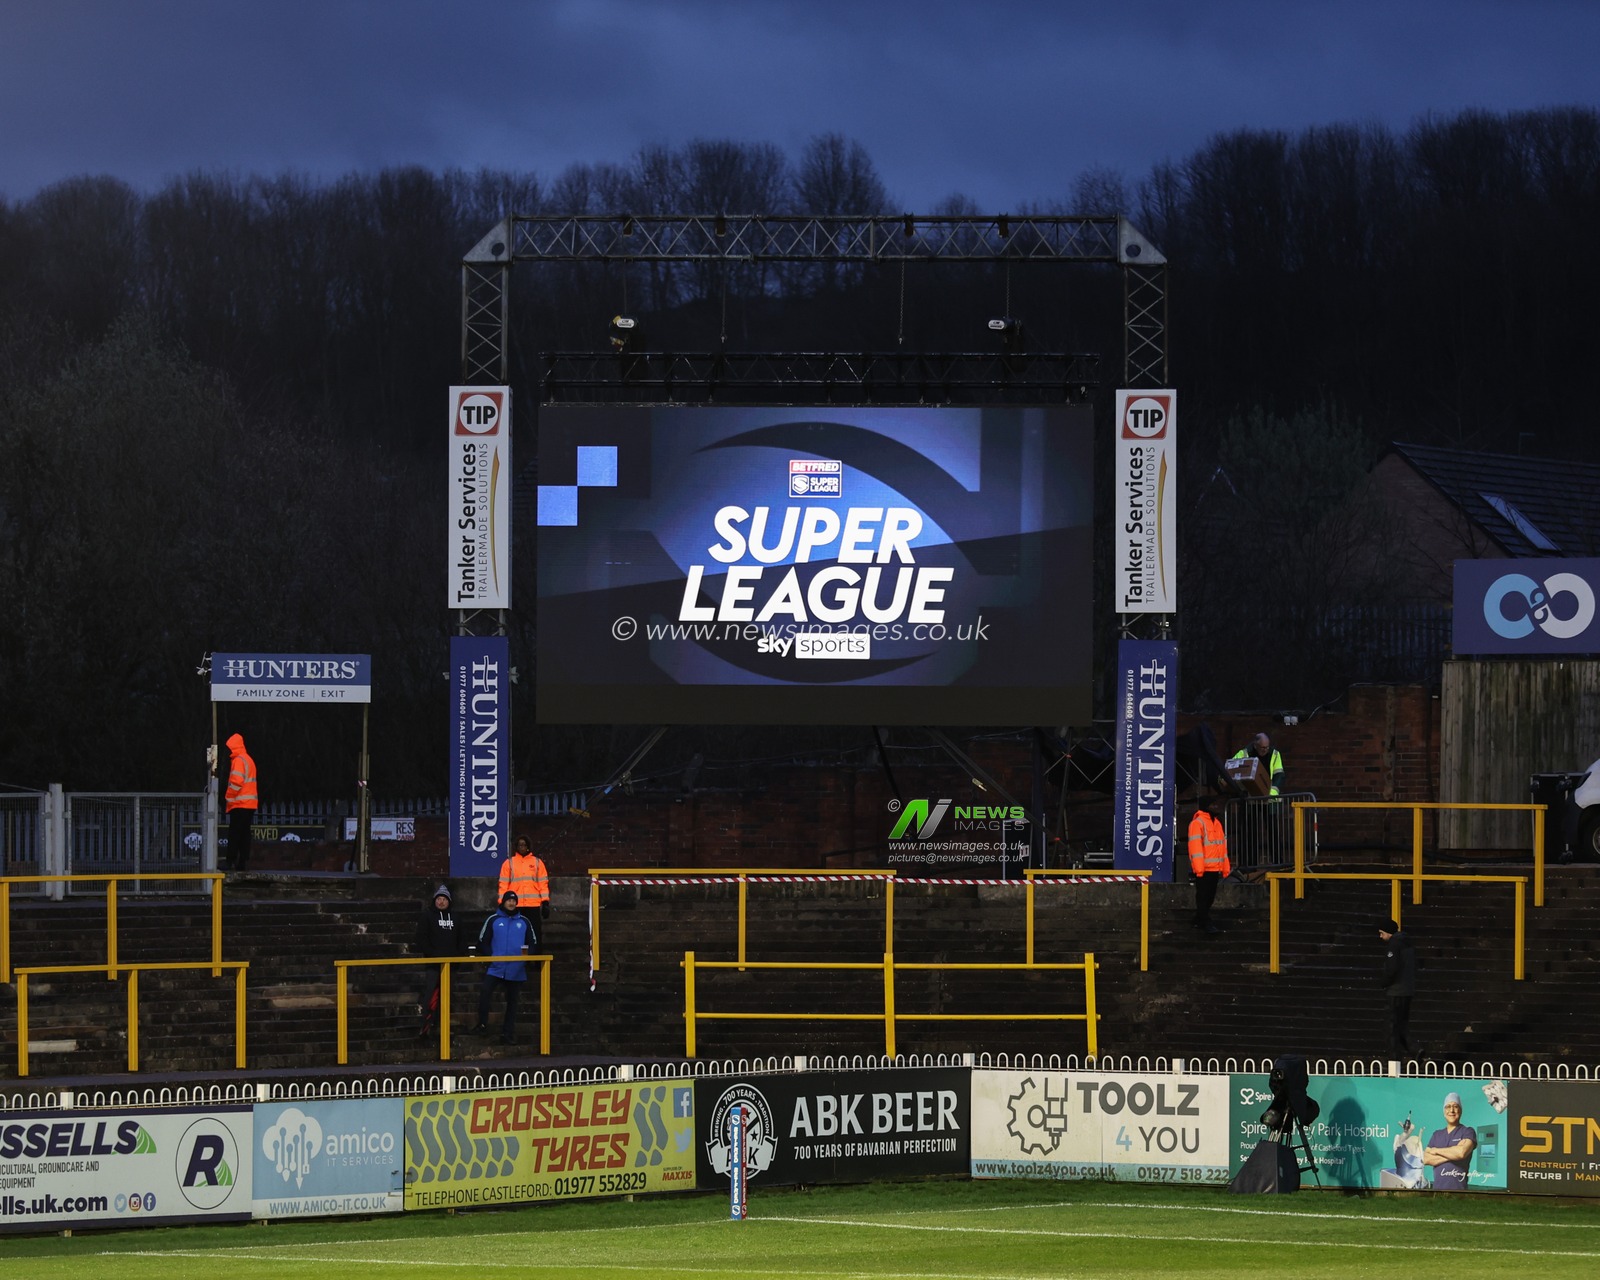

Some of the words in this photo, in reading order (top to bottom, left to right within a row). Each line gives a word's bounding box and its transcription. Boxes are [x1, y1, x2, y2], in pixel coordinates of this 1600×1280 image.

[463, 406, 496, 424] TIP
[1130, 410, 1163, 428] TIP
[478, 444, 488, 510] SOLUTIONS
[792, 462, 839, 472] BETFRED
[458, 444, 476, 530] Services
[810, 477, 838, 486] SUPER
[1125, 447, 1143, 534] Services
[1146, 446, 1155, 514] SOLUTIONS
[708, 506, 923, 564] SUPER
[458, 536, 476, 602] Tanker
[478, 517, 488, 598] TRAILERMADE
[1146, 521, 1155, 603] TRAILERMADE
[1125, 540, 1143, 607] Tanker
[678, 564, 955, 623] LEAGUE
[757, 633, 792, 657] sky
[800, 637, 866, 656] sports
[237, 689, 272, 697] FAMILY
[276, 690, 304, 698] ZONE
[251, 828, 278, 840] RVED
[396, 822, 415, 834] RES
[1077, 1081, 1200, 1116] TOOLZ
[1255, 1092, 1272, 1102] Spire
[470, 1089, 632, 1134] CROSSLEY
[714, 1107, 724, 1138] BREWING
[722, 1090, 736, 1105] 700
[736, 1088, 756, 1101] YEARS
[758, 1100, 770, 1134] TRADITION
[790, 1094, 865, 1138] ABK
[872, 1090, 960, 1134] BEER
[0, 1120, 140, 1159] SSELLS
[326, 1126, 394, 1156] amico
[1116, 1126, 1132, 1151] 4
[1138, 1126, 1200, 1153] YOU
[1240, 1120, 1267, 1138] Spire
[1318, 1122, 1341, 1136] Park
[1344, 1123, 1389, 1140] Hospital
[532, 1132, 630, 1173] TYRES
[726, 1146, 760, 1168] AK
[794, 1146, 811, 1160] 700
[814, 1144, 842, 1159] YEARS
[845, 1143, 856, 1156] OF
[858, 1140, 900, 1156] BAVARIAN
[904, 1138, 956, 1154] PERFECTION
[38, 1161, 84, 1174] GROUNDCARE
[86, 1160, 100, 1172] AND
[327, 1158, 336, 1166] IT
[342, 1156, 394, 1166] SERVICES
[976, 1162, 1116, 1178] www.toolz4you.co.uk
[1138, 1166, 1178, 1180] 01977
[1180, 1168, 1202, 1180] 518
[1206, 1168, 1229, 1182] 222
[1520, 1160, 1578, 1170] CONSTRUCT
[662, 1170, 692, 1181] MAXXIS
[1440, 1168, 1466, 1182] Looking
[1467, 1170, 1482, 1182] after
[1484, 1172, 1496, 1184] you
[1520, 1170, 1562, 1180] REFURB
[415, 1188, 480, 1206] TELEPHONE
[482, 1182, 552, 1202] CASTLEFORD:
[554, 1176, 595, 1196] 01977
[599, 1172, 646, 1192] 552829
[0, 1194, 108, 1215] lls.uk.com
[270, 1197, 386, 1215] WWW.AMICO-IT.CO.UK
